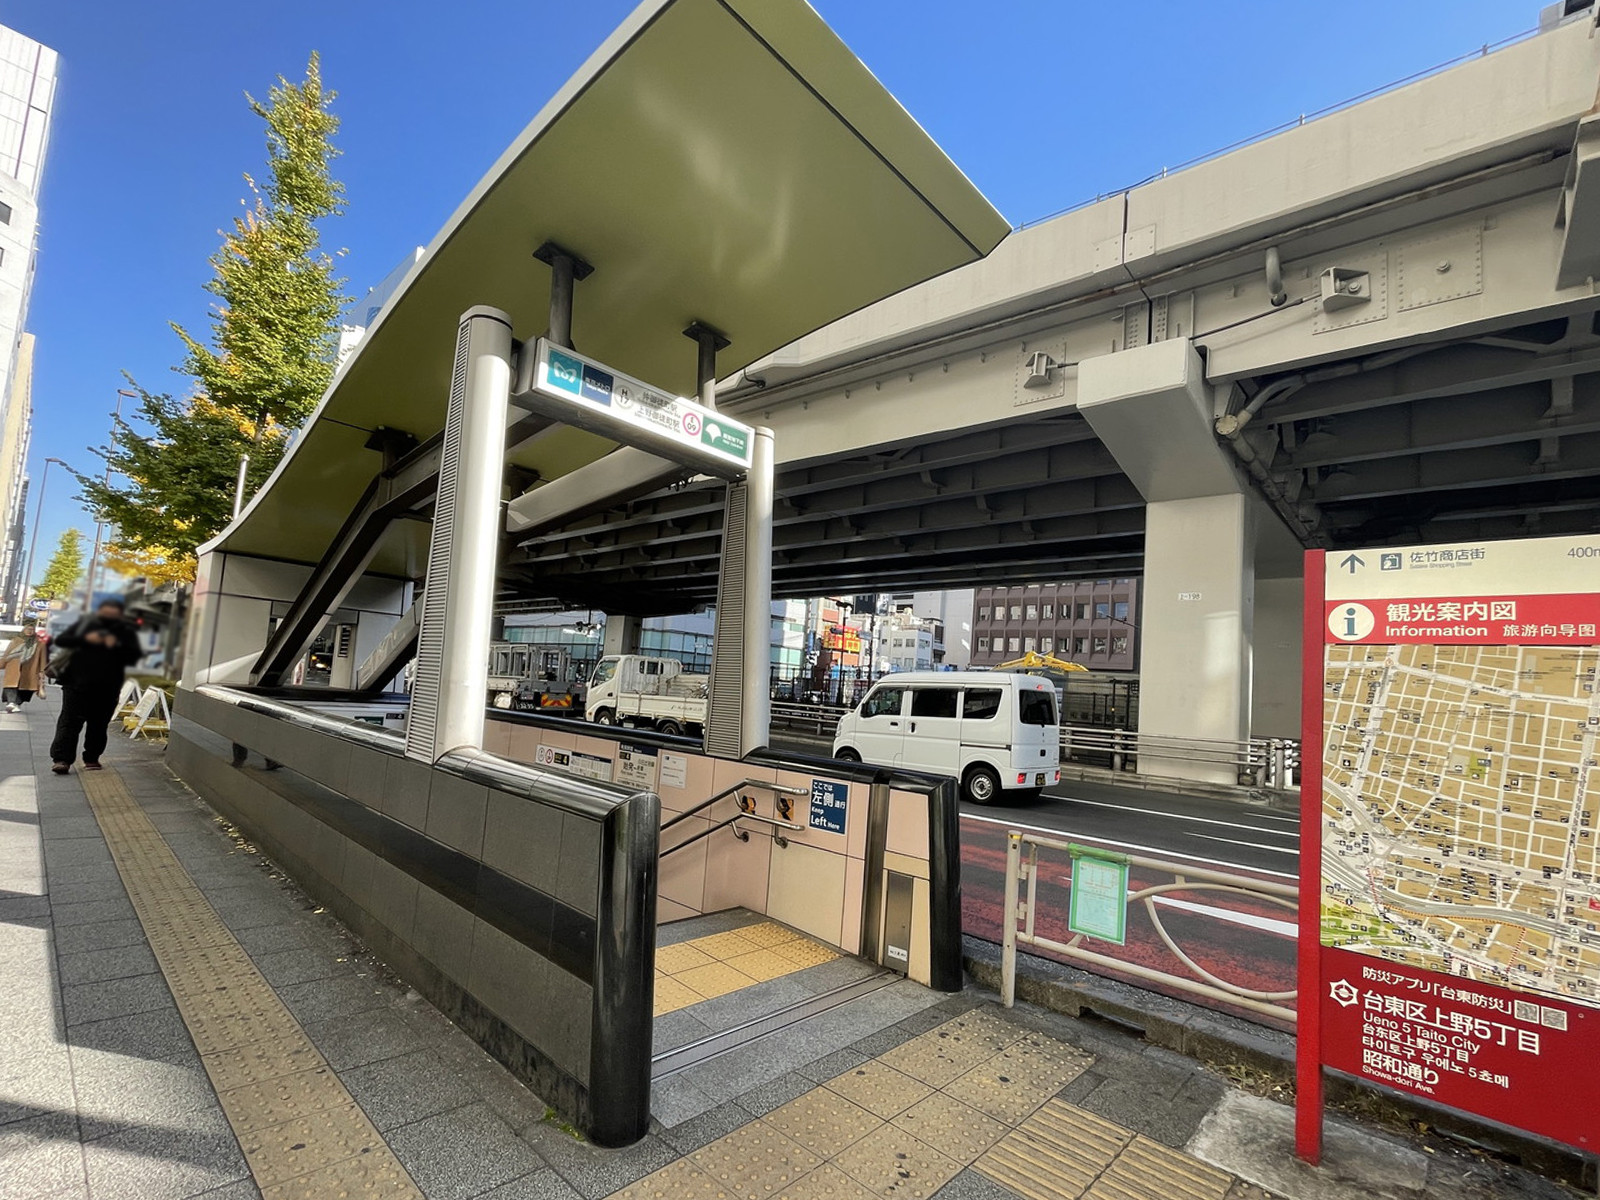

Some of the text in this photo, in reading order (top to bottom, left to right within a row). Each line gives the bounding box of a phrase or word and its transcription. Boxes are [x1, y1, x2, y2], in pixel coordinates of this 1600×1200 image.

[620, 395, 630, 404] 17
[1409, 547, 1485, 563] 佐竹商店街
[1386, 601, 1516, 623] 観光案内図
[1385, 625, 1488, 637] Information
[1503, 624, 1596, 638] 旅游向导图
[813, 781, 833, 791] ここでは
[811, 806, 824, 815] Keep
[811, 815, 827, 827] Left
[1362, 966, 1512, 1015] 防災アプリ「台東防災」
[1362, 990, 1540, 1055] 台東区上野5丁目
[1363, 1011, 1480, 1054] Ueno 5 Taito City
[1363, 1023, 1469, 1063] 台东区上野5丁目
[1362, 1036, 1416, 1060] 타이토구
[1421, 1052, 1465, 1074] 우에노
[1363, 1048, 1439, 1085] 昭和通り
[1362, 1064, 1435, 1095] Showa-dori Ave.
